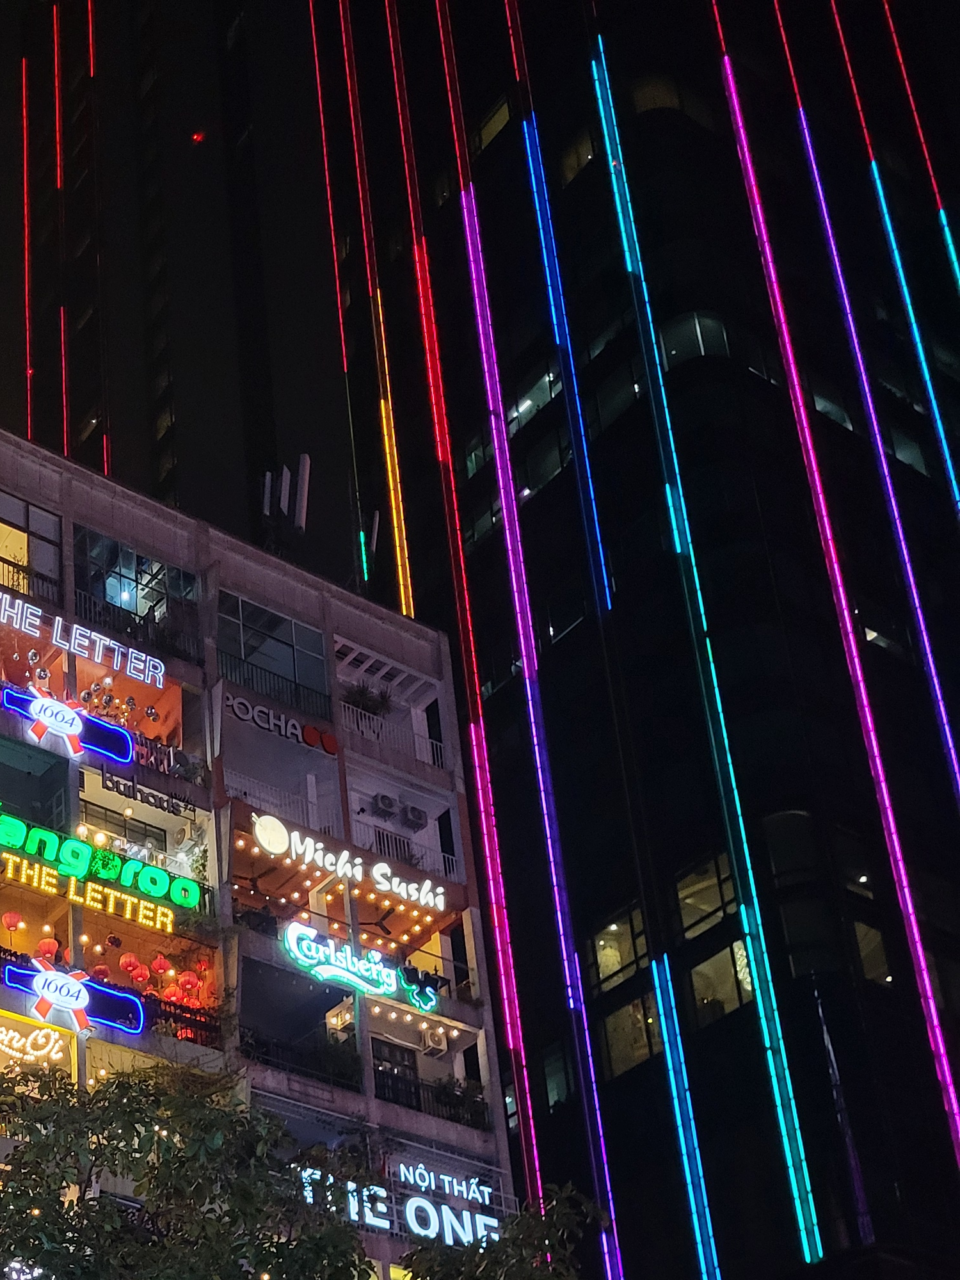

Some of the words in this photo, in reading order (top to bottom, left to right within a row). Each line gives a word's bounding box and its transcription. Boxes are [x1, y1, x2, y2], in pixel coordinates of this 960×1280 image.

[52, 616, 166, 689] LETTER
[35, 703, 76, 728] 1664
[1, 852, 58, 894] THE
[68, 876, 174, 933] LETTER
[290, 831, 363, 882] Michi
[372, 862, 444, 911] Sushi
[42, 978, 84, 1002] 1664
[285, 921, 398, 993] Carlsberg
[399, 1163, 436, 1192] NỘI
